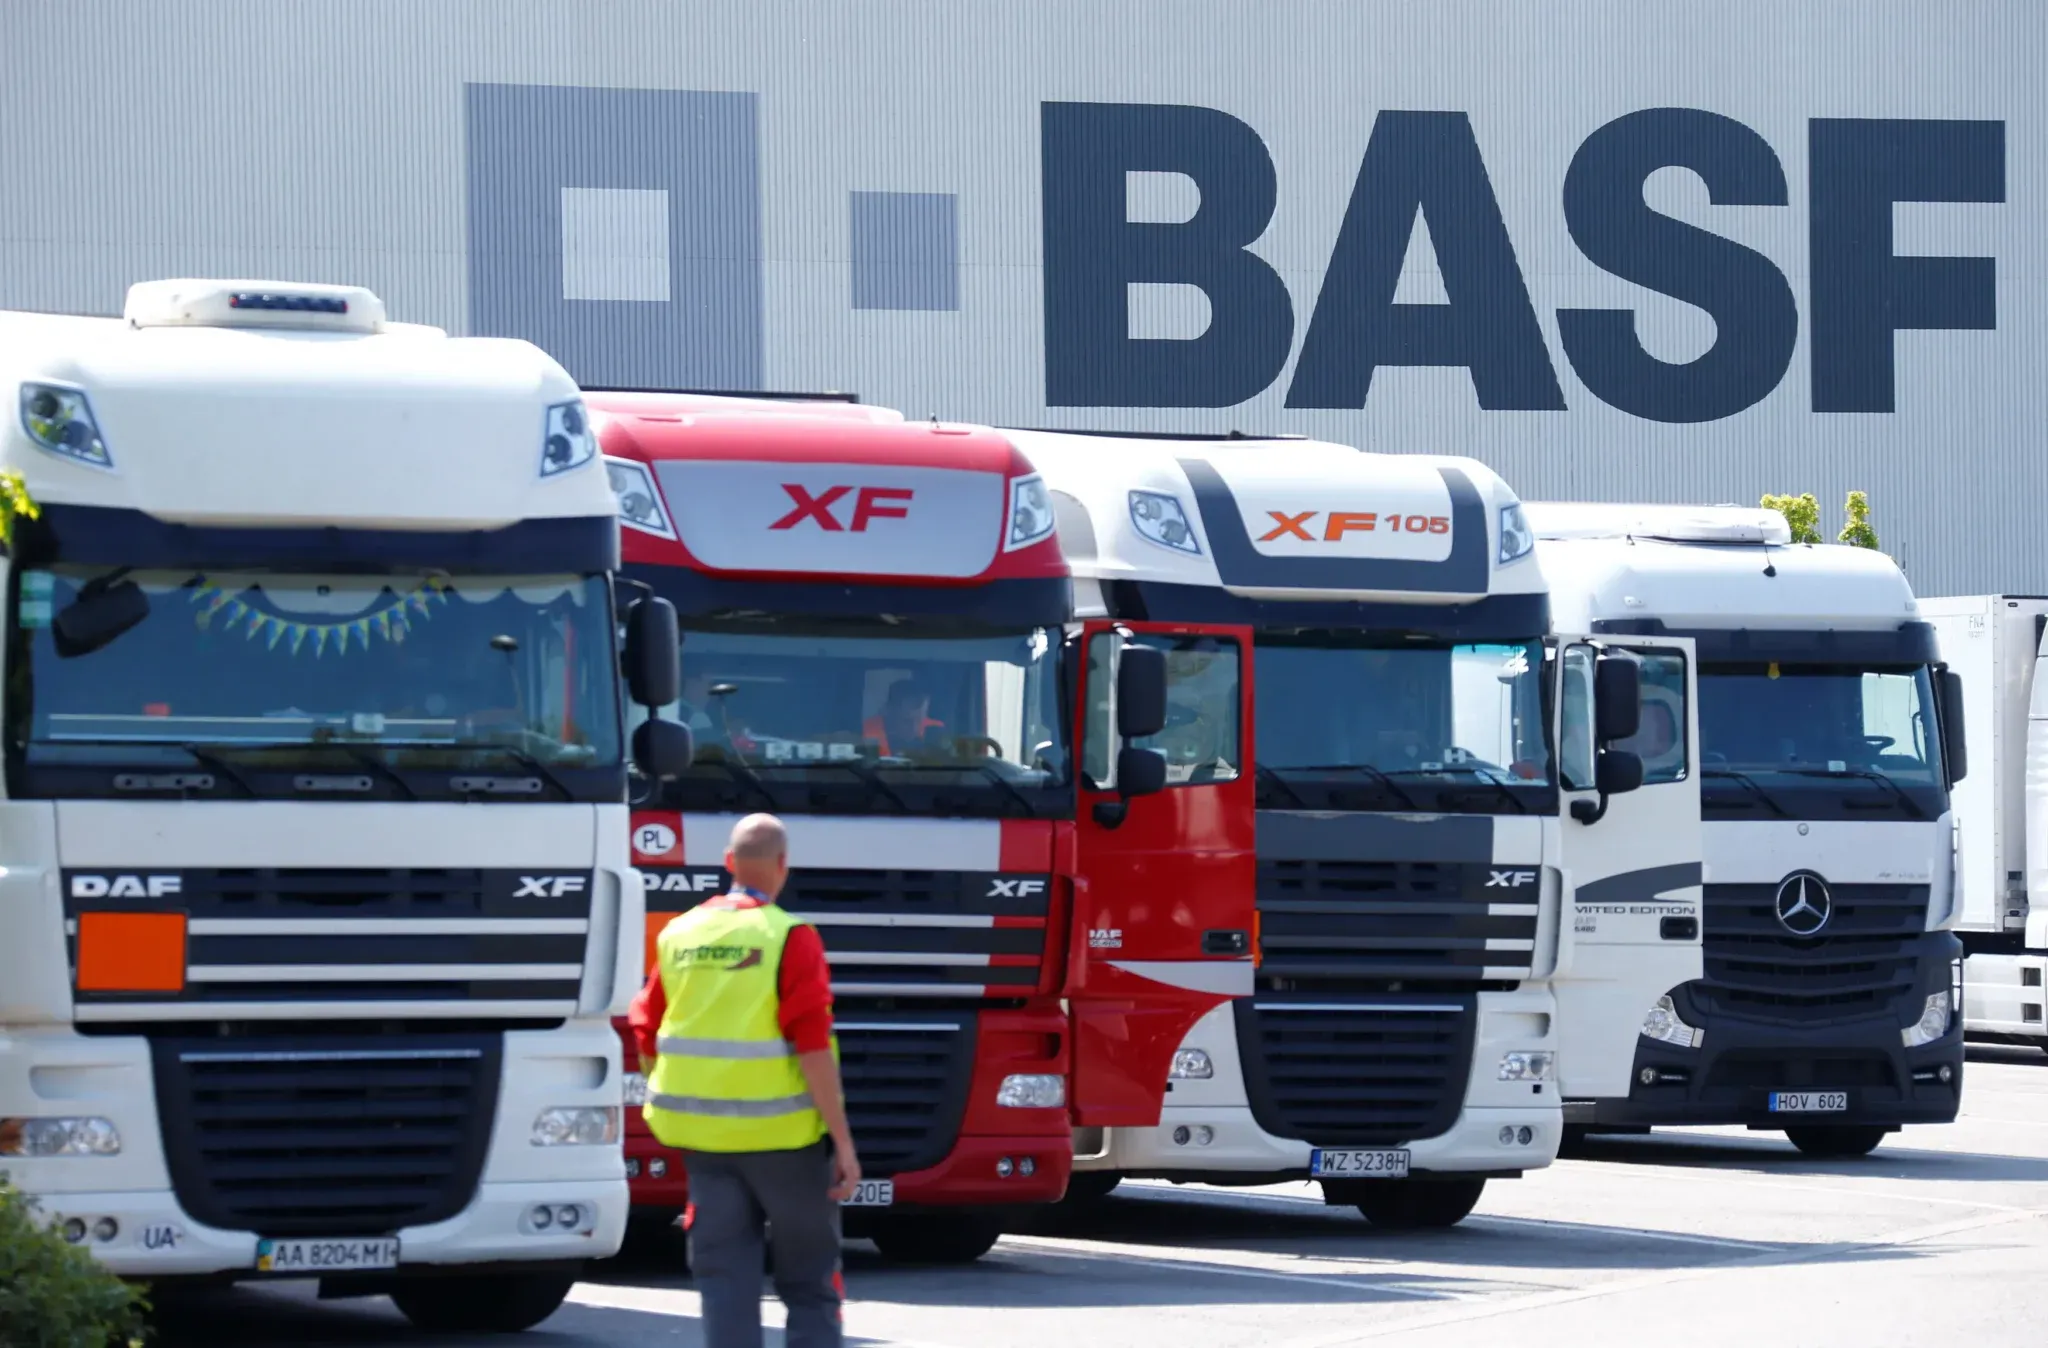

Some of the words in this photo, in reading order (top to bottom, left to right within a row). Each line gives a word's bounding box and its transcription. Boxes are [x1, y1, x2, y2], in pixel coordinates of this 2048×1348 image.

[1041, 101, 2006, 424] BASF
[768, 482, 914, 533] XF
[1257, 511, 1377, 541] XF
[1384, 514, 1450, 534] 105
[643, 830, 667, 849] PL
[71, 875, 182, 898] DAF
[512, 876, 586, 897] XF
[643, 873, 720, 892] DAF
[985, 879, 1046, 897] XF
[1485, 870, 1537, 887] XF
[1575, 906, 1626, 914] MITED
[1629, 906, 1696, 914] EDITION
[1778, 1095, 1809, 1109] HOV
[1818, 1095, 1845, 1109] 602
[1323, 1152, 1348, 1171] WZ
[1353, 1152, 1407, 1171] 5238H
[144, 1227, 176, 1250] UA
[275, 1245, 303, 1266] AA
[310, 1244, 358, 1265] 8204
